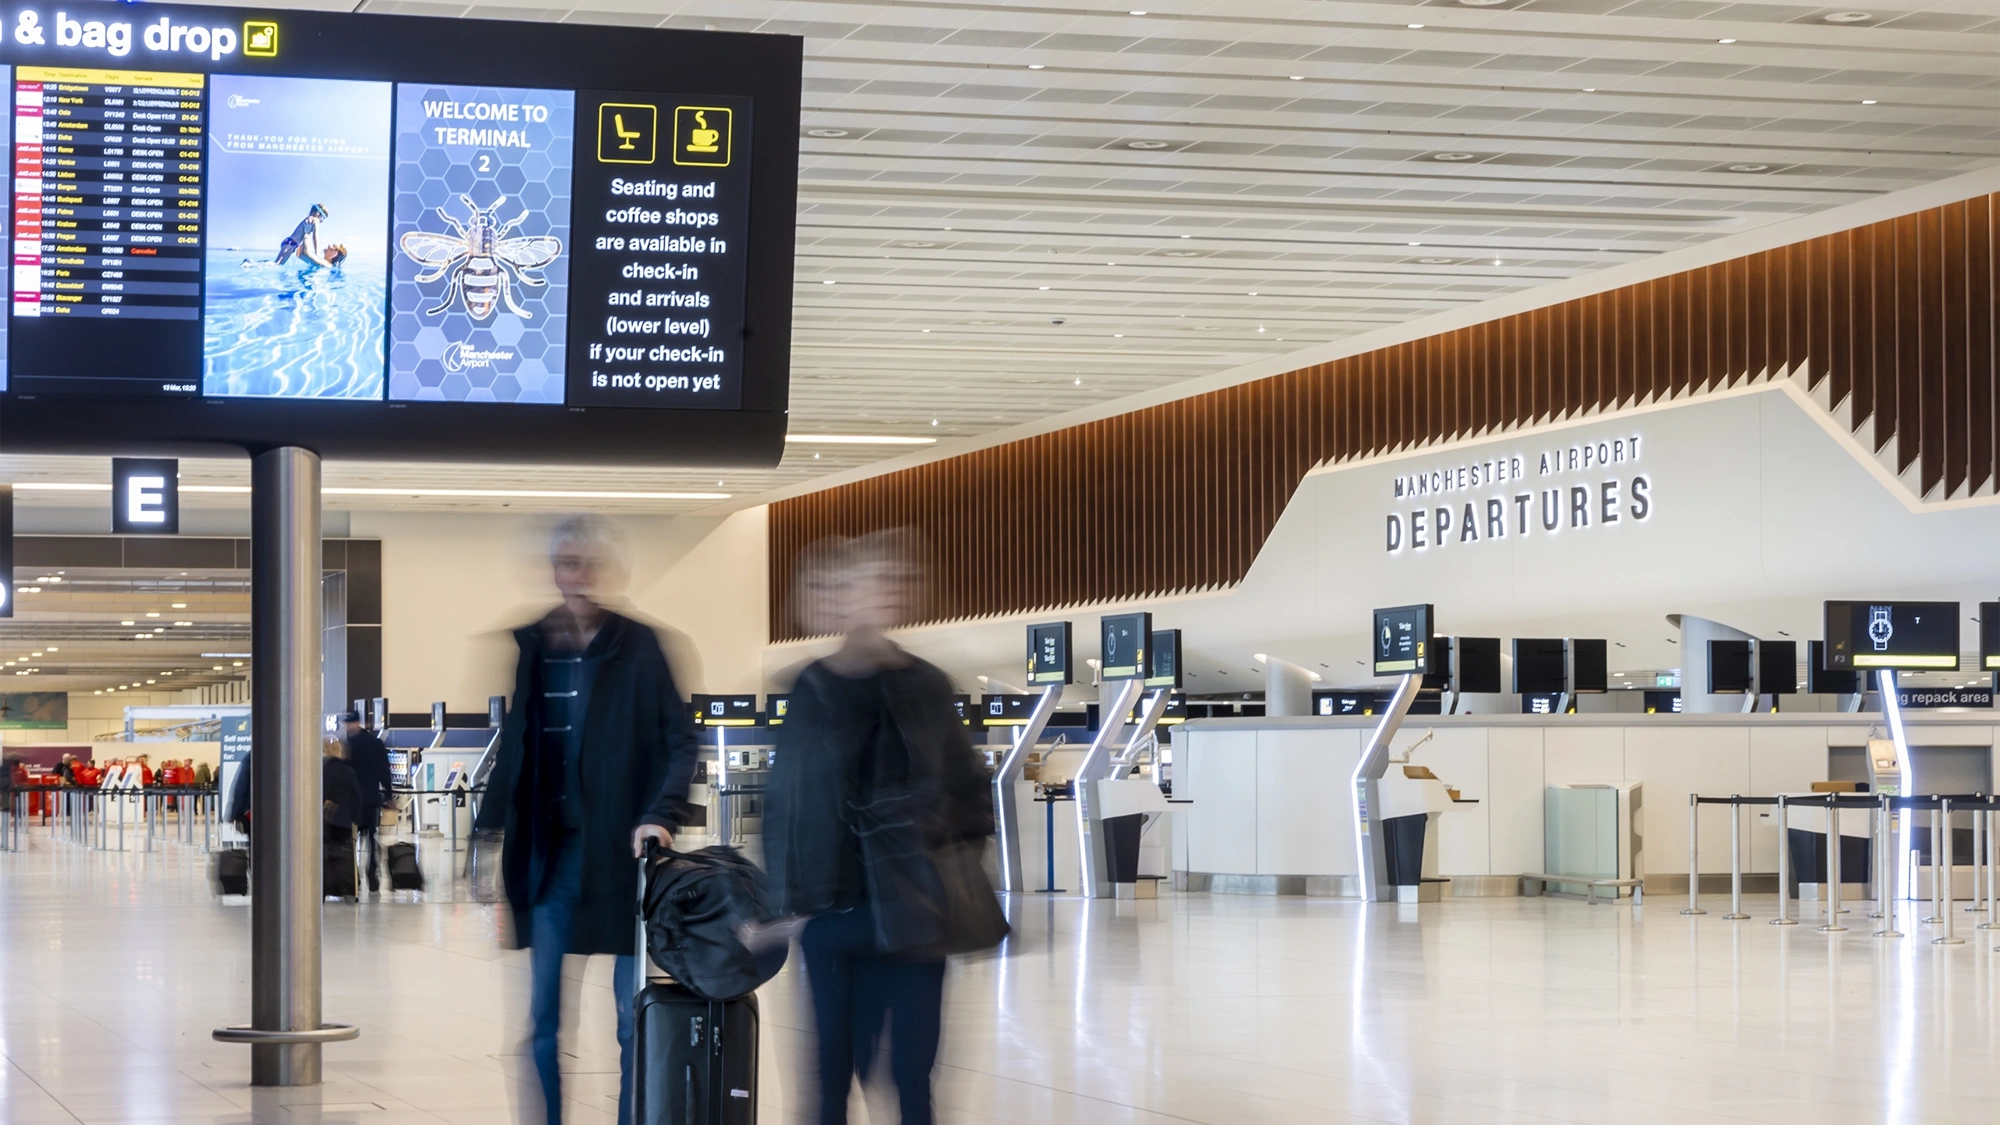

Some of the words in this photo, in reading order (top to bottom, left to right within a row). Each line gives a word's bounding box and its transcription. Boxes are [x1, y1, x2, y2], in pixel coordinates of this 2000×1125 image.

[15, 10, 45, 45] &
[56, 12, 131, 55] bag
[144, 17, 236, 60] drop
[424, 101, 518, 122] WELCOME
[522, 105, 548, 122] TO
[227, 133, 283, 142] THANK-YOU
[312, 137, 346, 145] FLYING
[258, 143, 323, 151] MANCHESTER
[435, 127, 530, 148] TERMINAL
[479, 156, 490, 172] 2
[611, 178, 678, 200] Seating
[682, 182, 715, 198] and
[606, 207, 661, 224] coffee
[666, 210, 719, 228] shops
[596, 237, 625, 250] are
[629, 236, 706, 253] available
[710, 239, 726, 253] in
[622, 263, 698, 280] check-in
[608, 290, 642, 306] and
[646, 291, 710, 308] arrivals
[606, 317, 661, 336] (lower
[664, 318, 710, 338] level)
[460, 350, 514, 360] Manchester
[460, 359, 489, 369] Airport
[590, 344, 602, 360] if
[605, 348, 646, 364] your
[649, 345, 724, 363] check-in
[592, 371, 608, 388] is
[612, 372, 641, 388] not
[645, 376, 689, 393] open
[693, 374, 720, 393] yet
[1394, 458, 1521, 498] MANCHESTER
[1540, 437, 1639, 474] AIRPORT
[128, 477, 165, 522] E
[1386, 476, 1649, 551] DEPARTURES
[1912, 691, 1957, 705] repack
[1960, 694, 1989, 703] area
